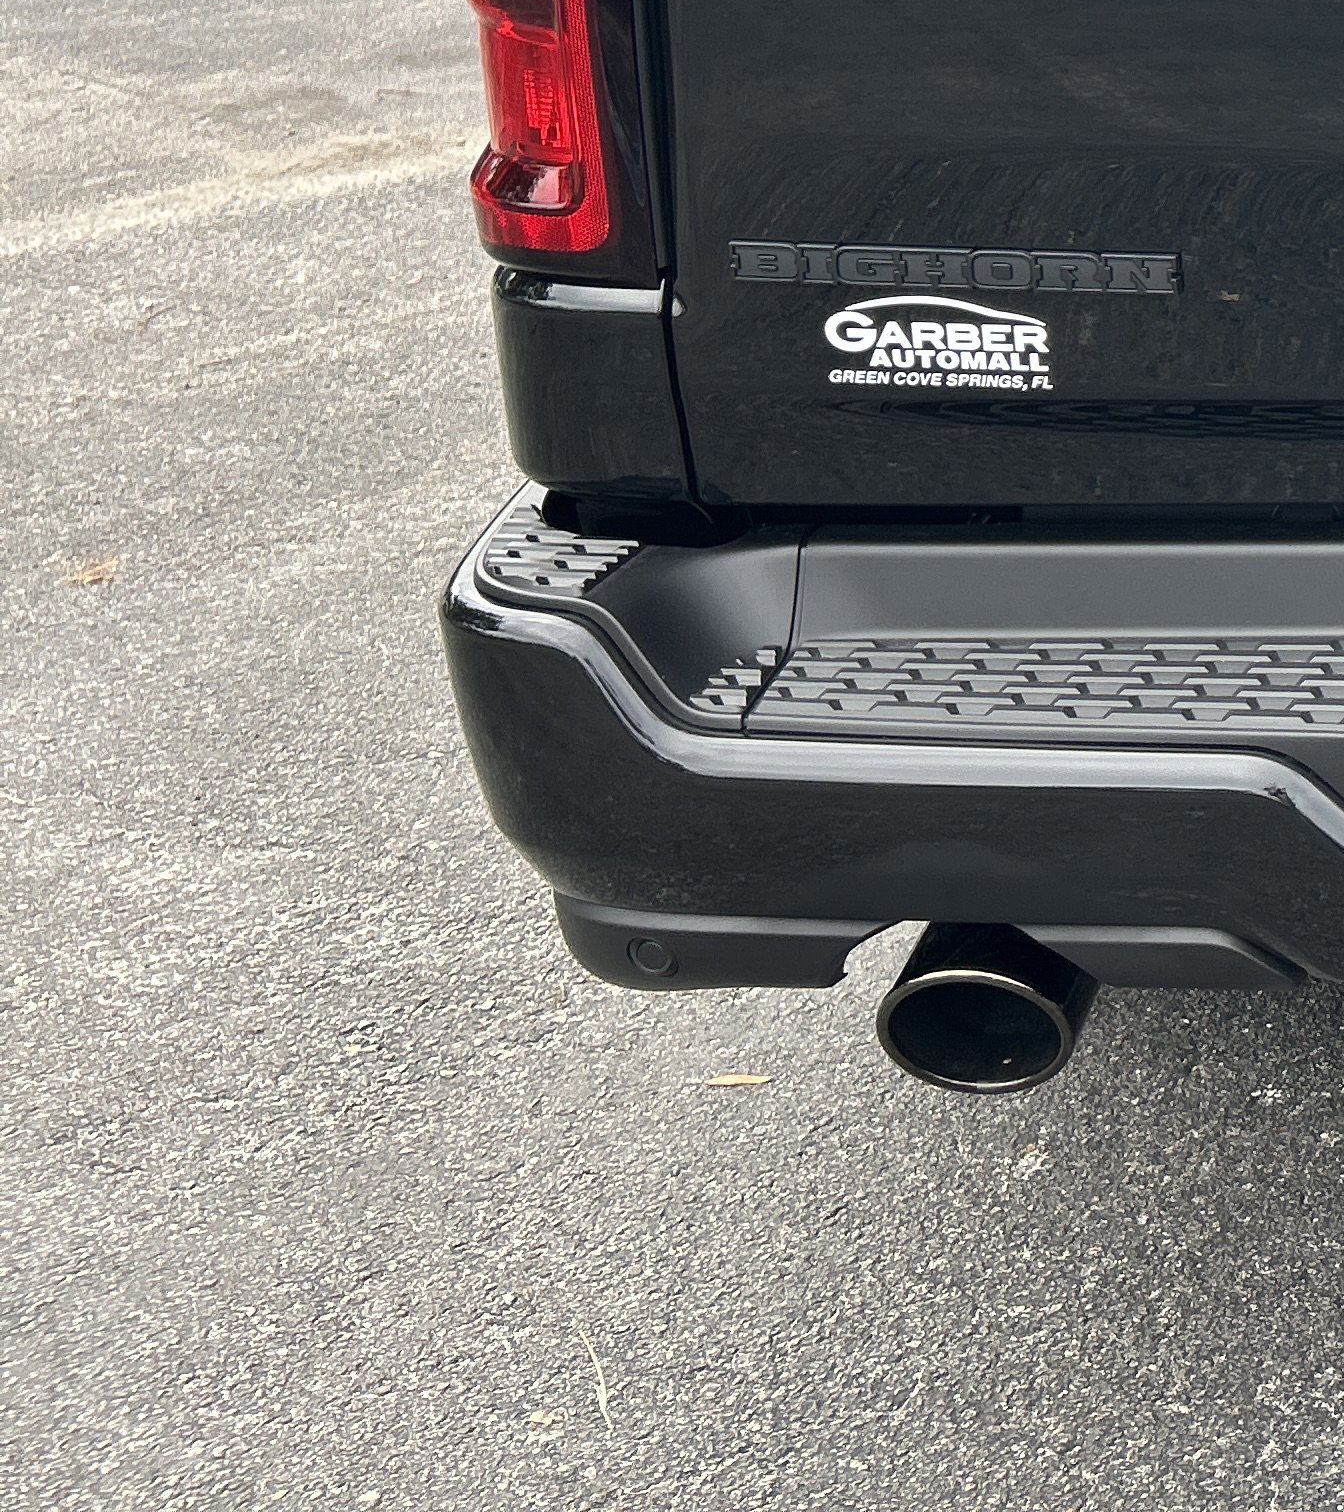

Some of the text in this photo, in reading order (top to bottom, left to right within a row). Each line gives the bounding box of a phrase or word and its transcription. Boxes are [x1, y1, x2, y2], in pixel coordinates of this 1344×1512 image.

[728, 239, 1184, 294] BIGHORN
[824, 309, 1050, 353] GARBER
[869, 348, 1050, 372] AUTOMALL
[828, 369, 1054, 391] GREEN COVE SPRINGS, FL
